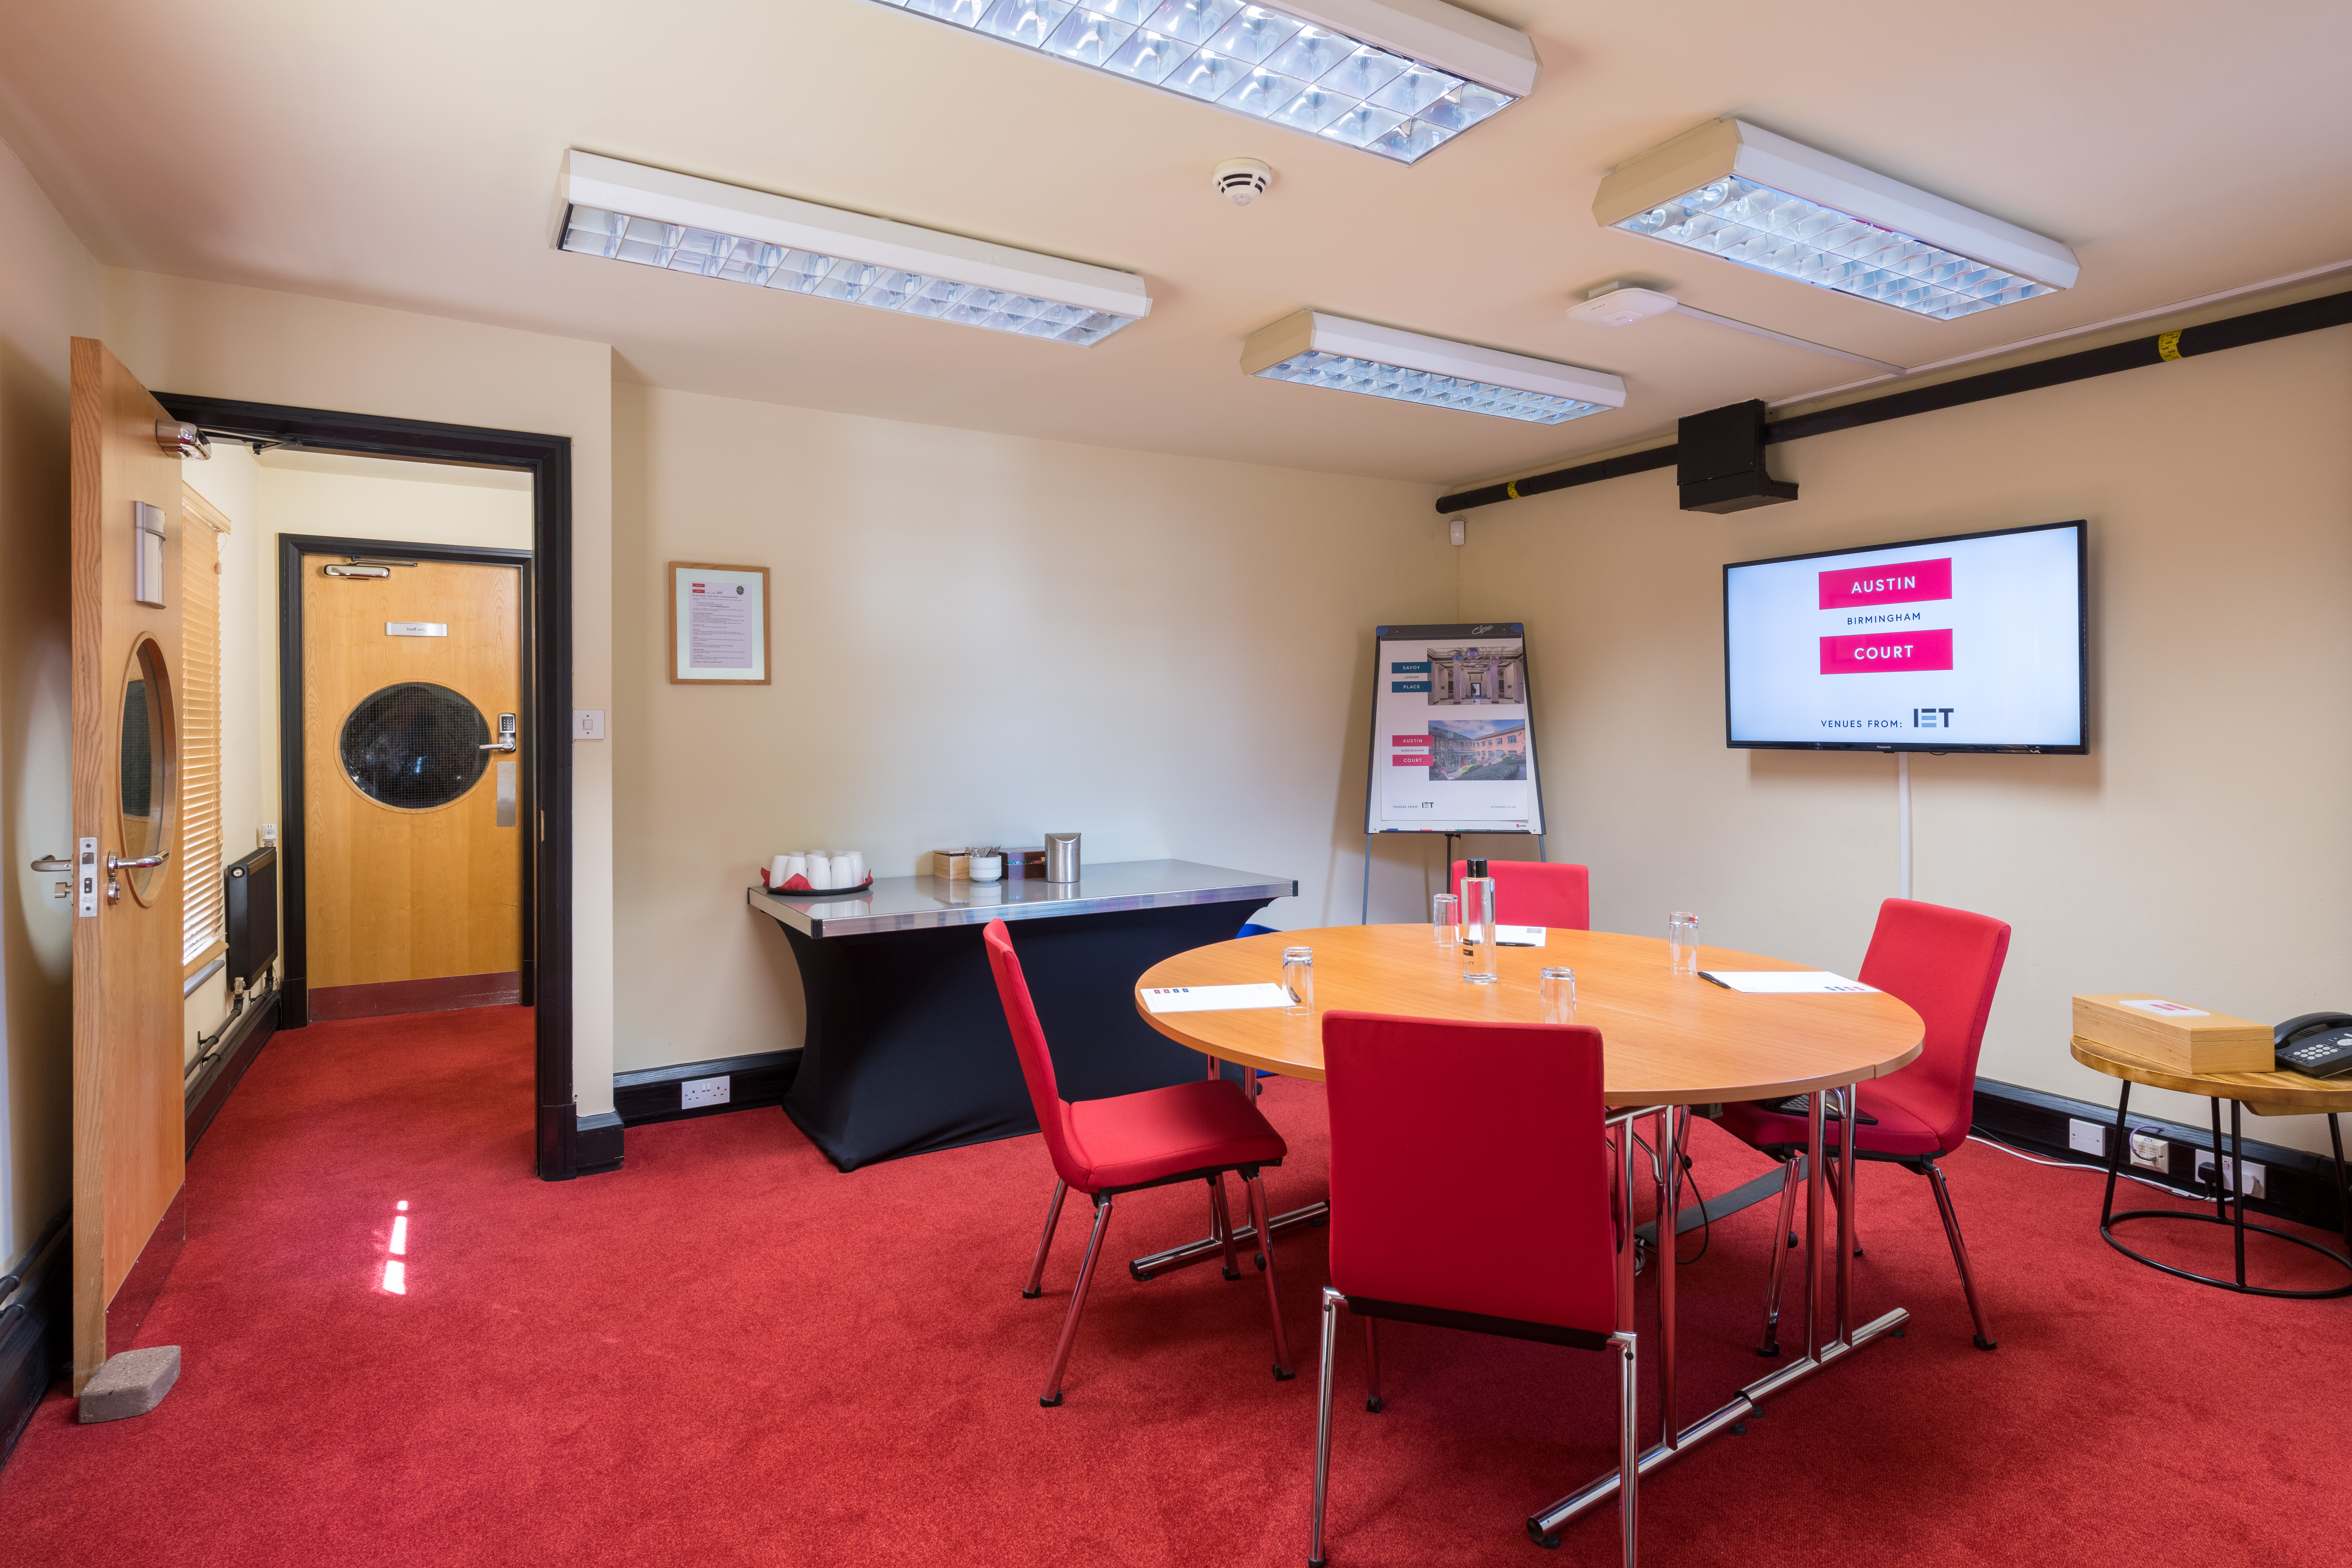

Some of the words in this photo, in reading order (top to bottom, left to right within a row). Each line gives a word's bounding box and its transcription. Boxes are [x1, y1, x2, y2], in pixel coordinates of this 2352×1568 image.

[1851, 576, 1915, 594] AUSTIN
[1847, 612, 1920, 625] BIRMINGHAM
[1472, 625, 1494, 634] Classic
[1854, 645, 1913, 660] COURT
[1914, 708, 1954, 728] IET
